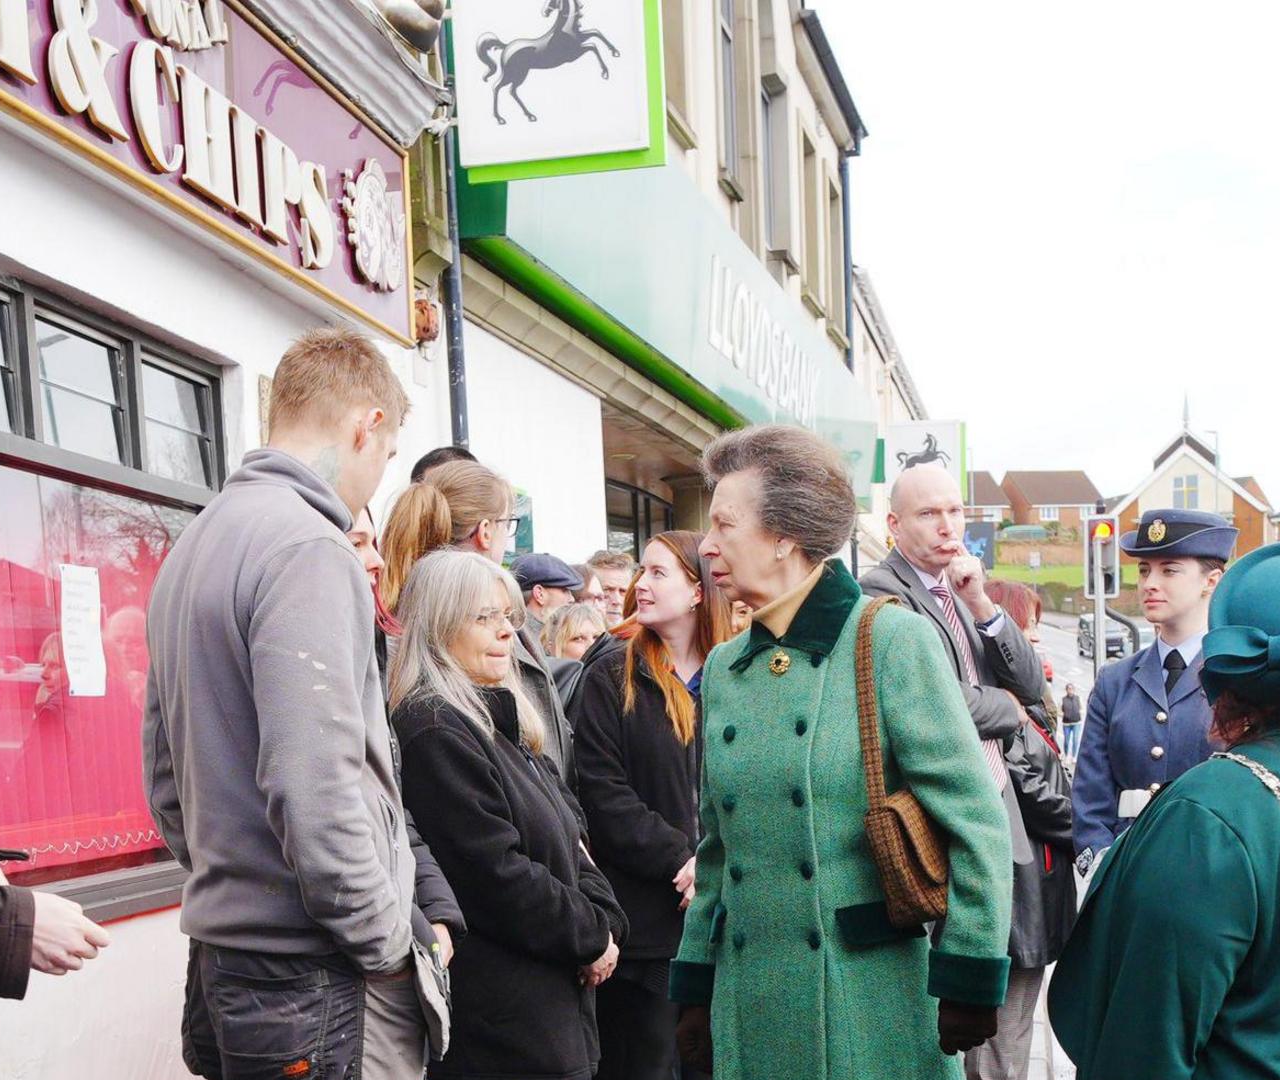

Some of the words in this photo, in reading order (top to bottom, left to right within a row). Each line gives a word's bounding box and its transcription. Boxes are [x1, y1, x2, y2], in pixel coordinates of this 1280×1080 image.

[130, 39, 334, 270] CHIPS
[708, 254, 781, 399] LLOYDS
[778, 330, 820, 431] BANK
